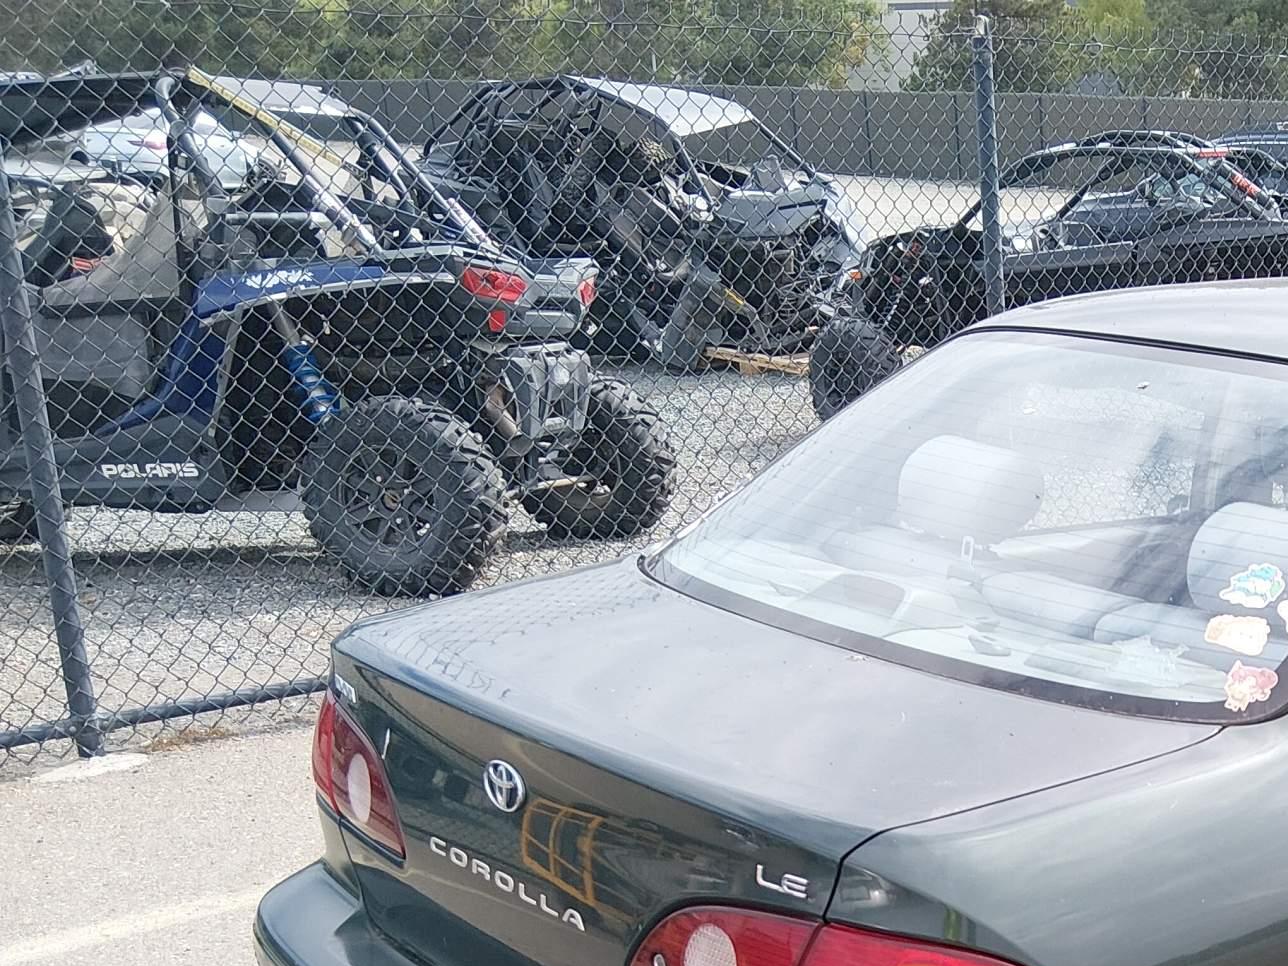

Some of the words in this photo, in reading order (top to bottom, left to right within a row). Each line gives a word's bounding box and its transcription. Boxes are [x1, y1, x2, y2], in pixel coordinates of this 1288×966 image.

[101, 462, 199, 479] POLARIS
[429, 835, 586, 932] COROLLA
[756, 863, 809, 899] LE
